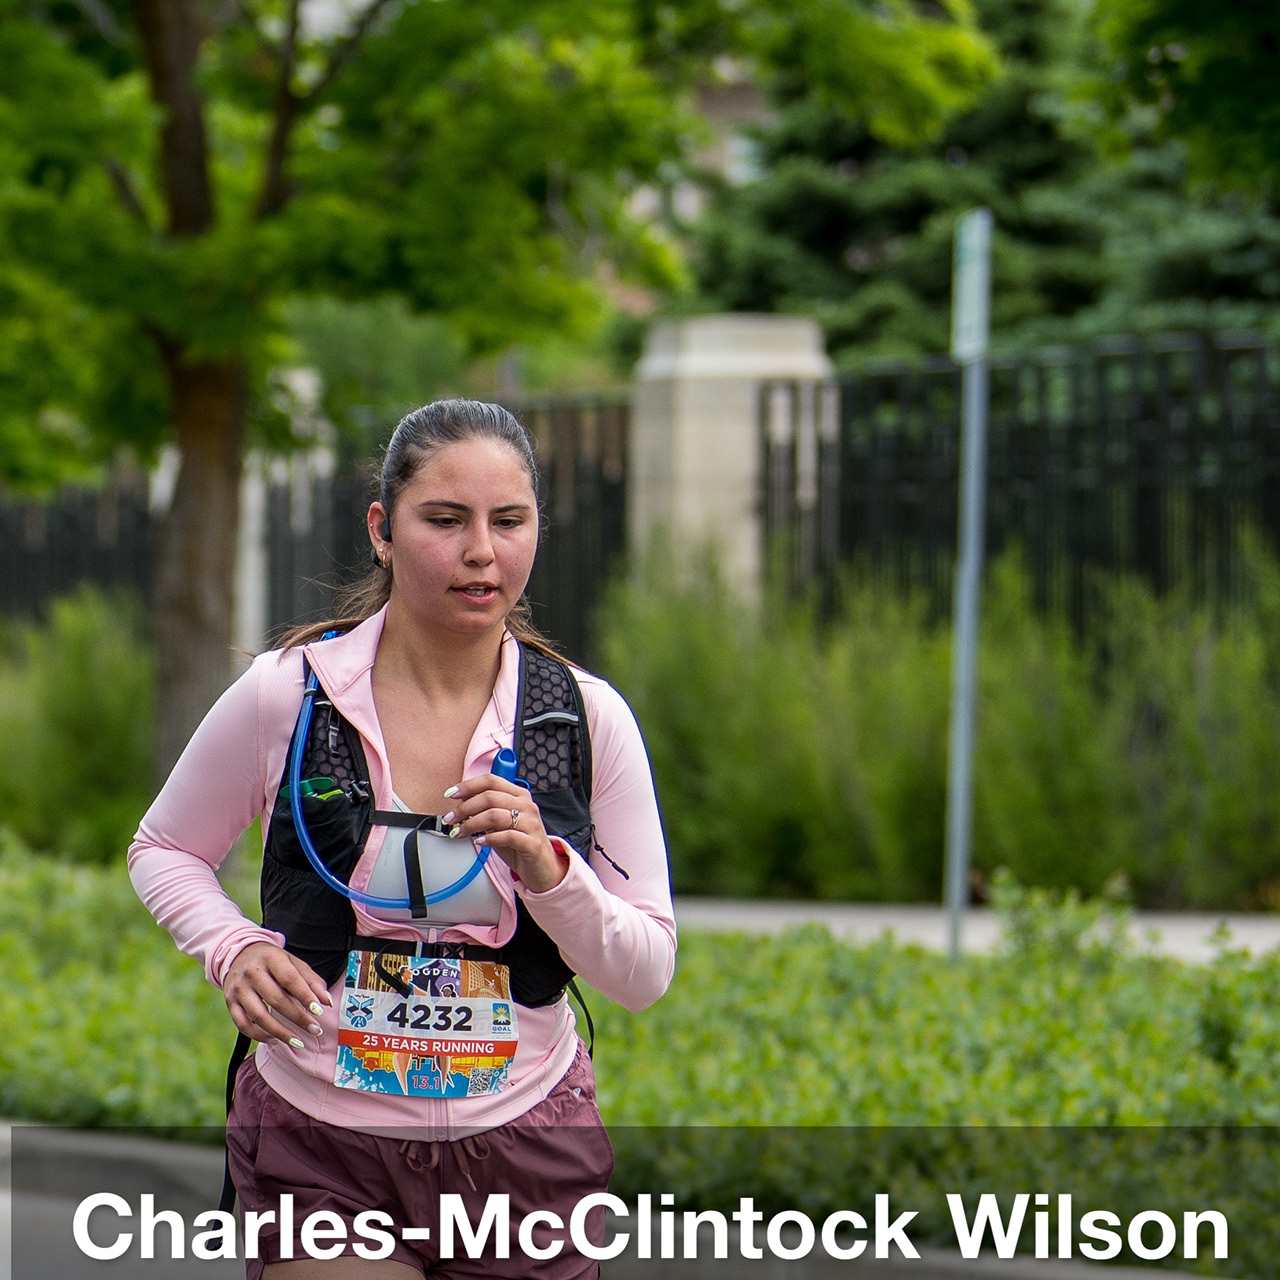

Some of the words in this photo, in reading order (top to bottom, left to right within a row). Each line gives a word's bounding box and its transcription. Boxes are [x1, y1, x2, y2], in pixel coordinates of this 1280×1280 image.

[412, 968, 458, 978] OGDEN
[387, 1002, 473, 1032] 4232
[362, 1035, 378, 1046] 25
[382, 1037, 428, 1052] YEARS
[432, 1041, 495, 1054] RUNNING
[412, 1076, 440, 1090] 13.1
